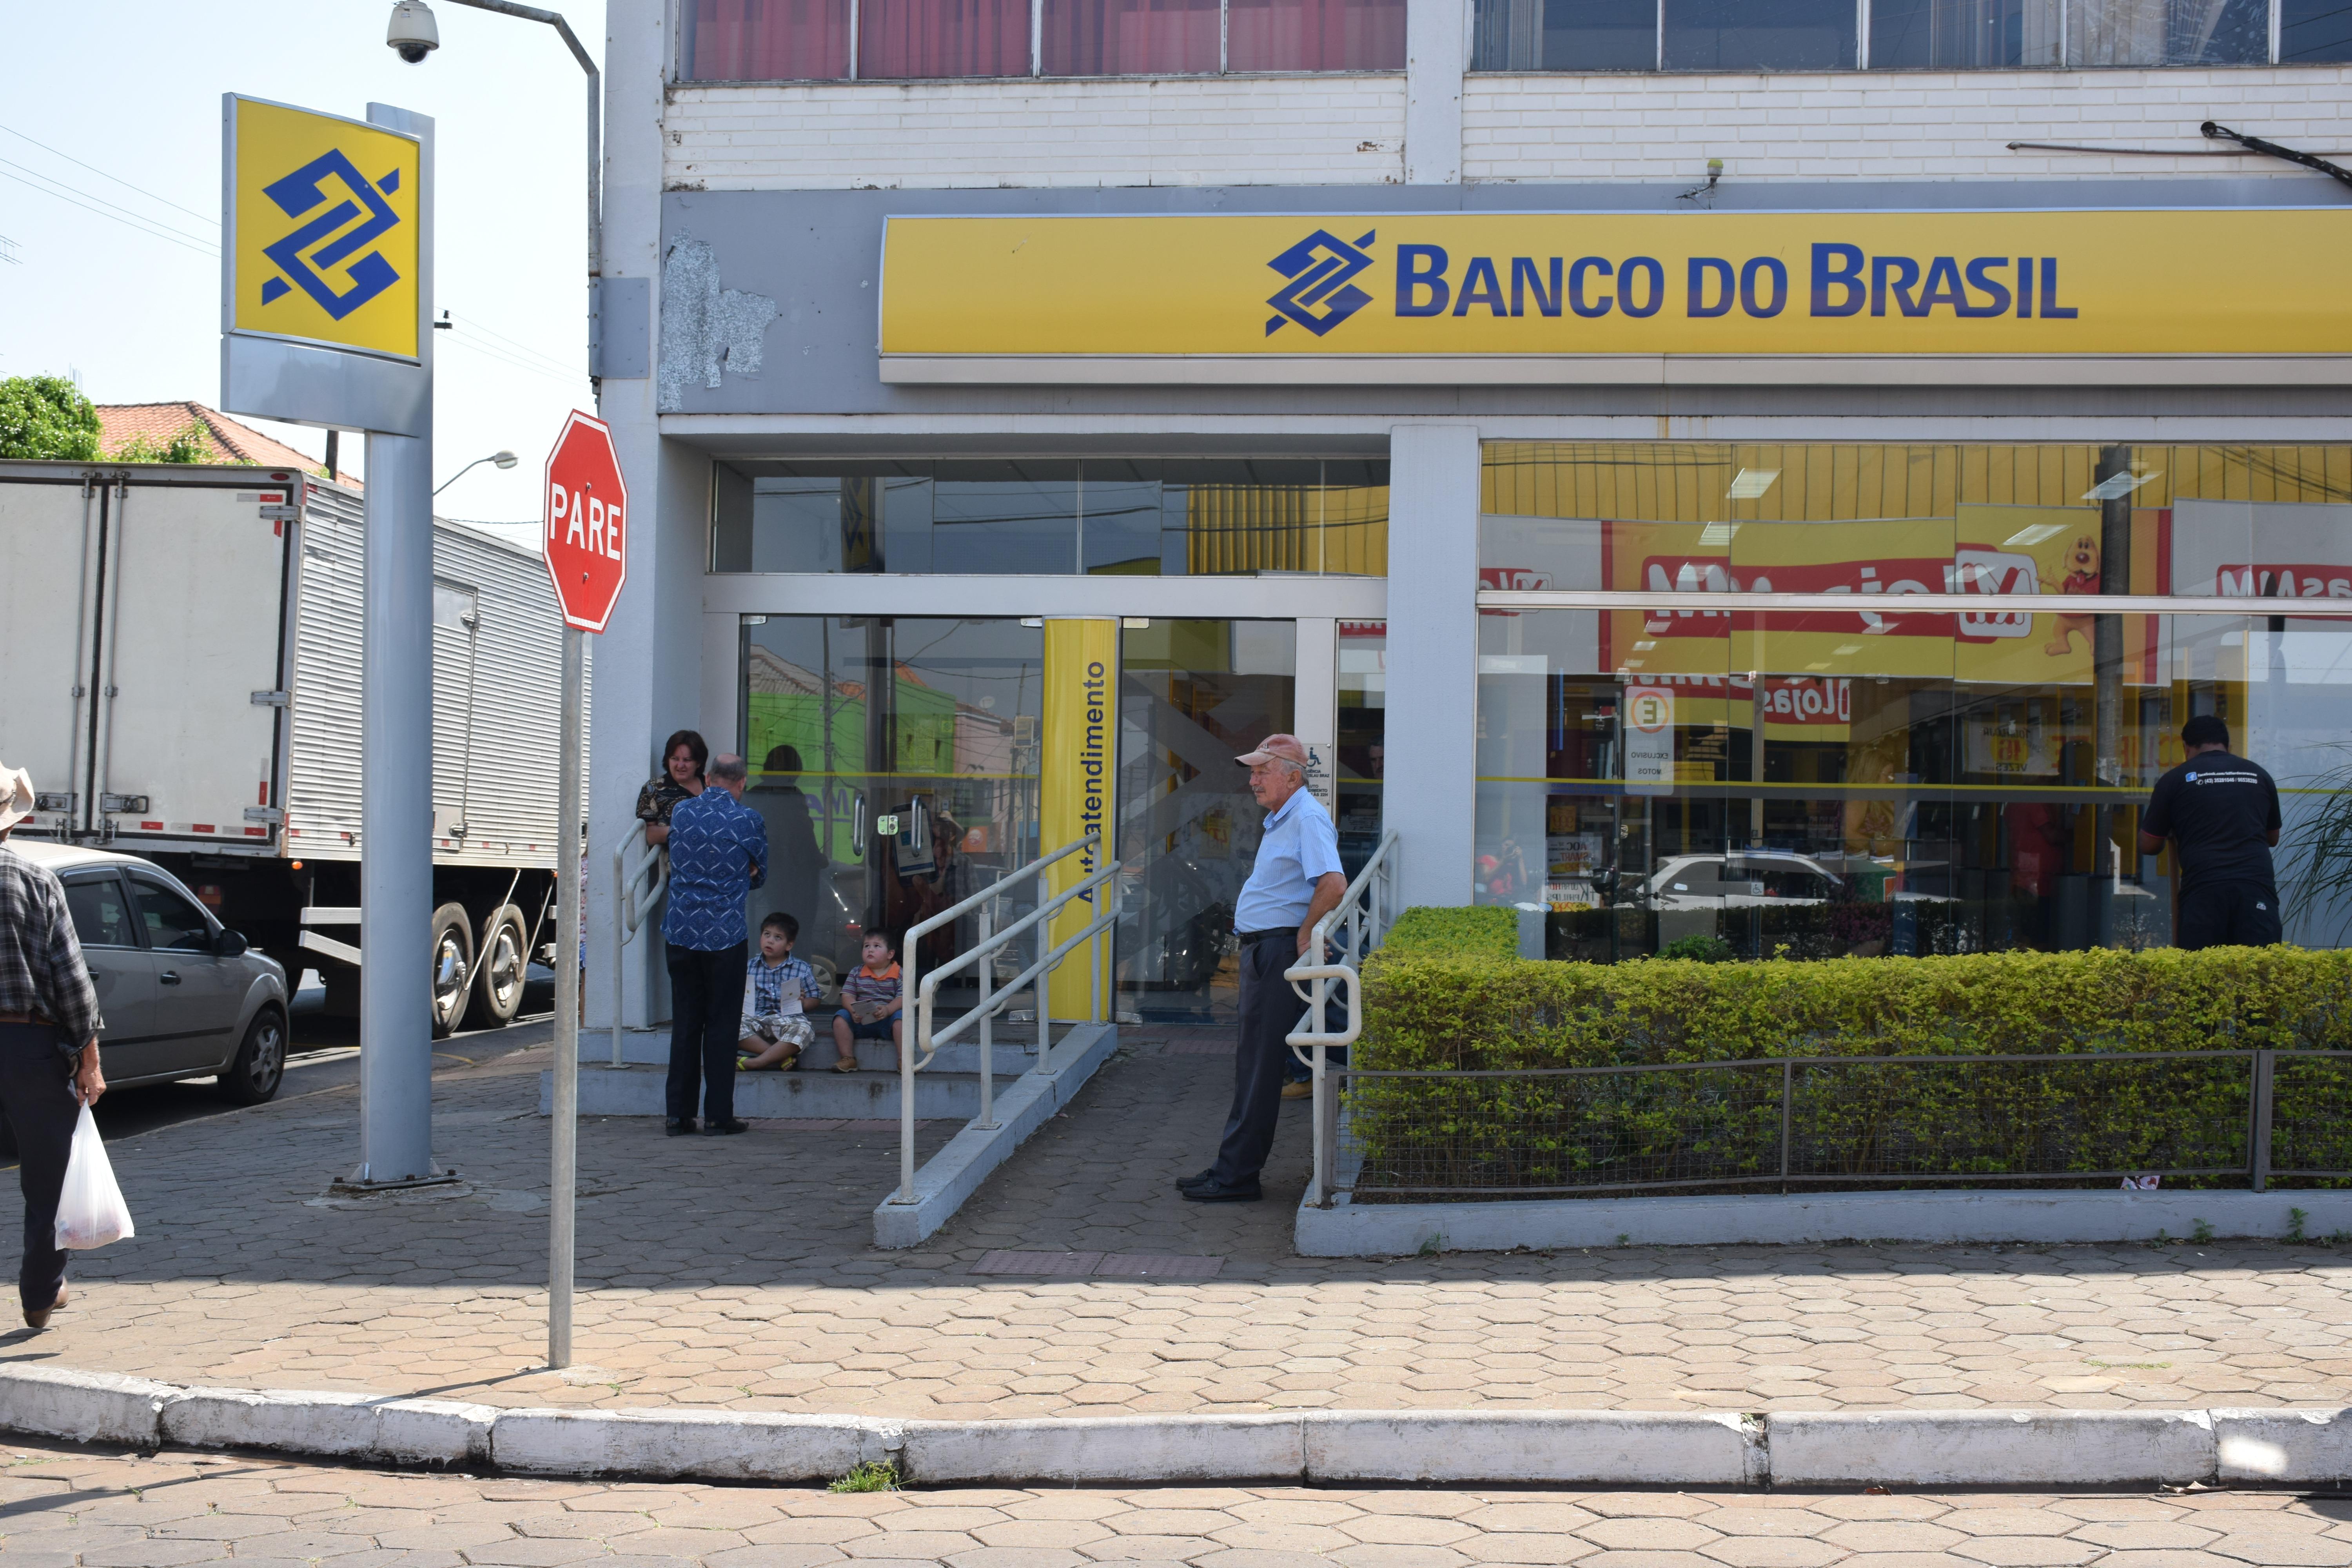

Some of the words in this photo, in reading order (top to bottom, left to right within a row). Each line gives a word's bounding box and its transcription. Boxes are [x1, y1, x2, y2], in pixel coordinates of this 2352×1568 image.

[1395, 243, 1665, 318] BANCO
[1686, 256, 1788, 319] DO
[1809, 243, 2078, 319] BRASIL
[550, 482, 621, 561] PARE
